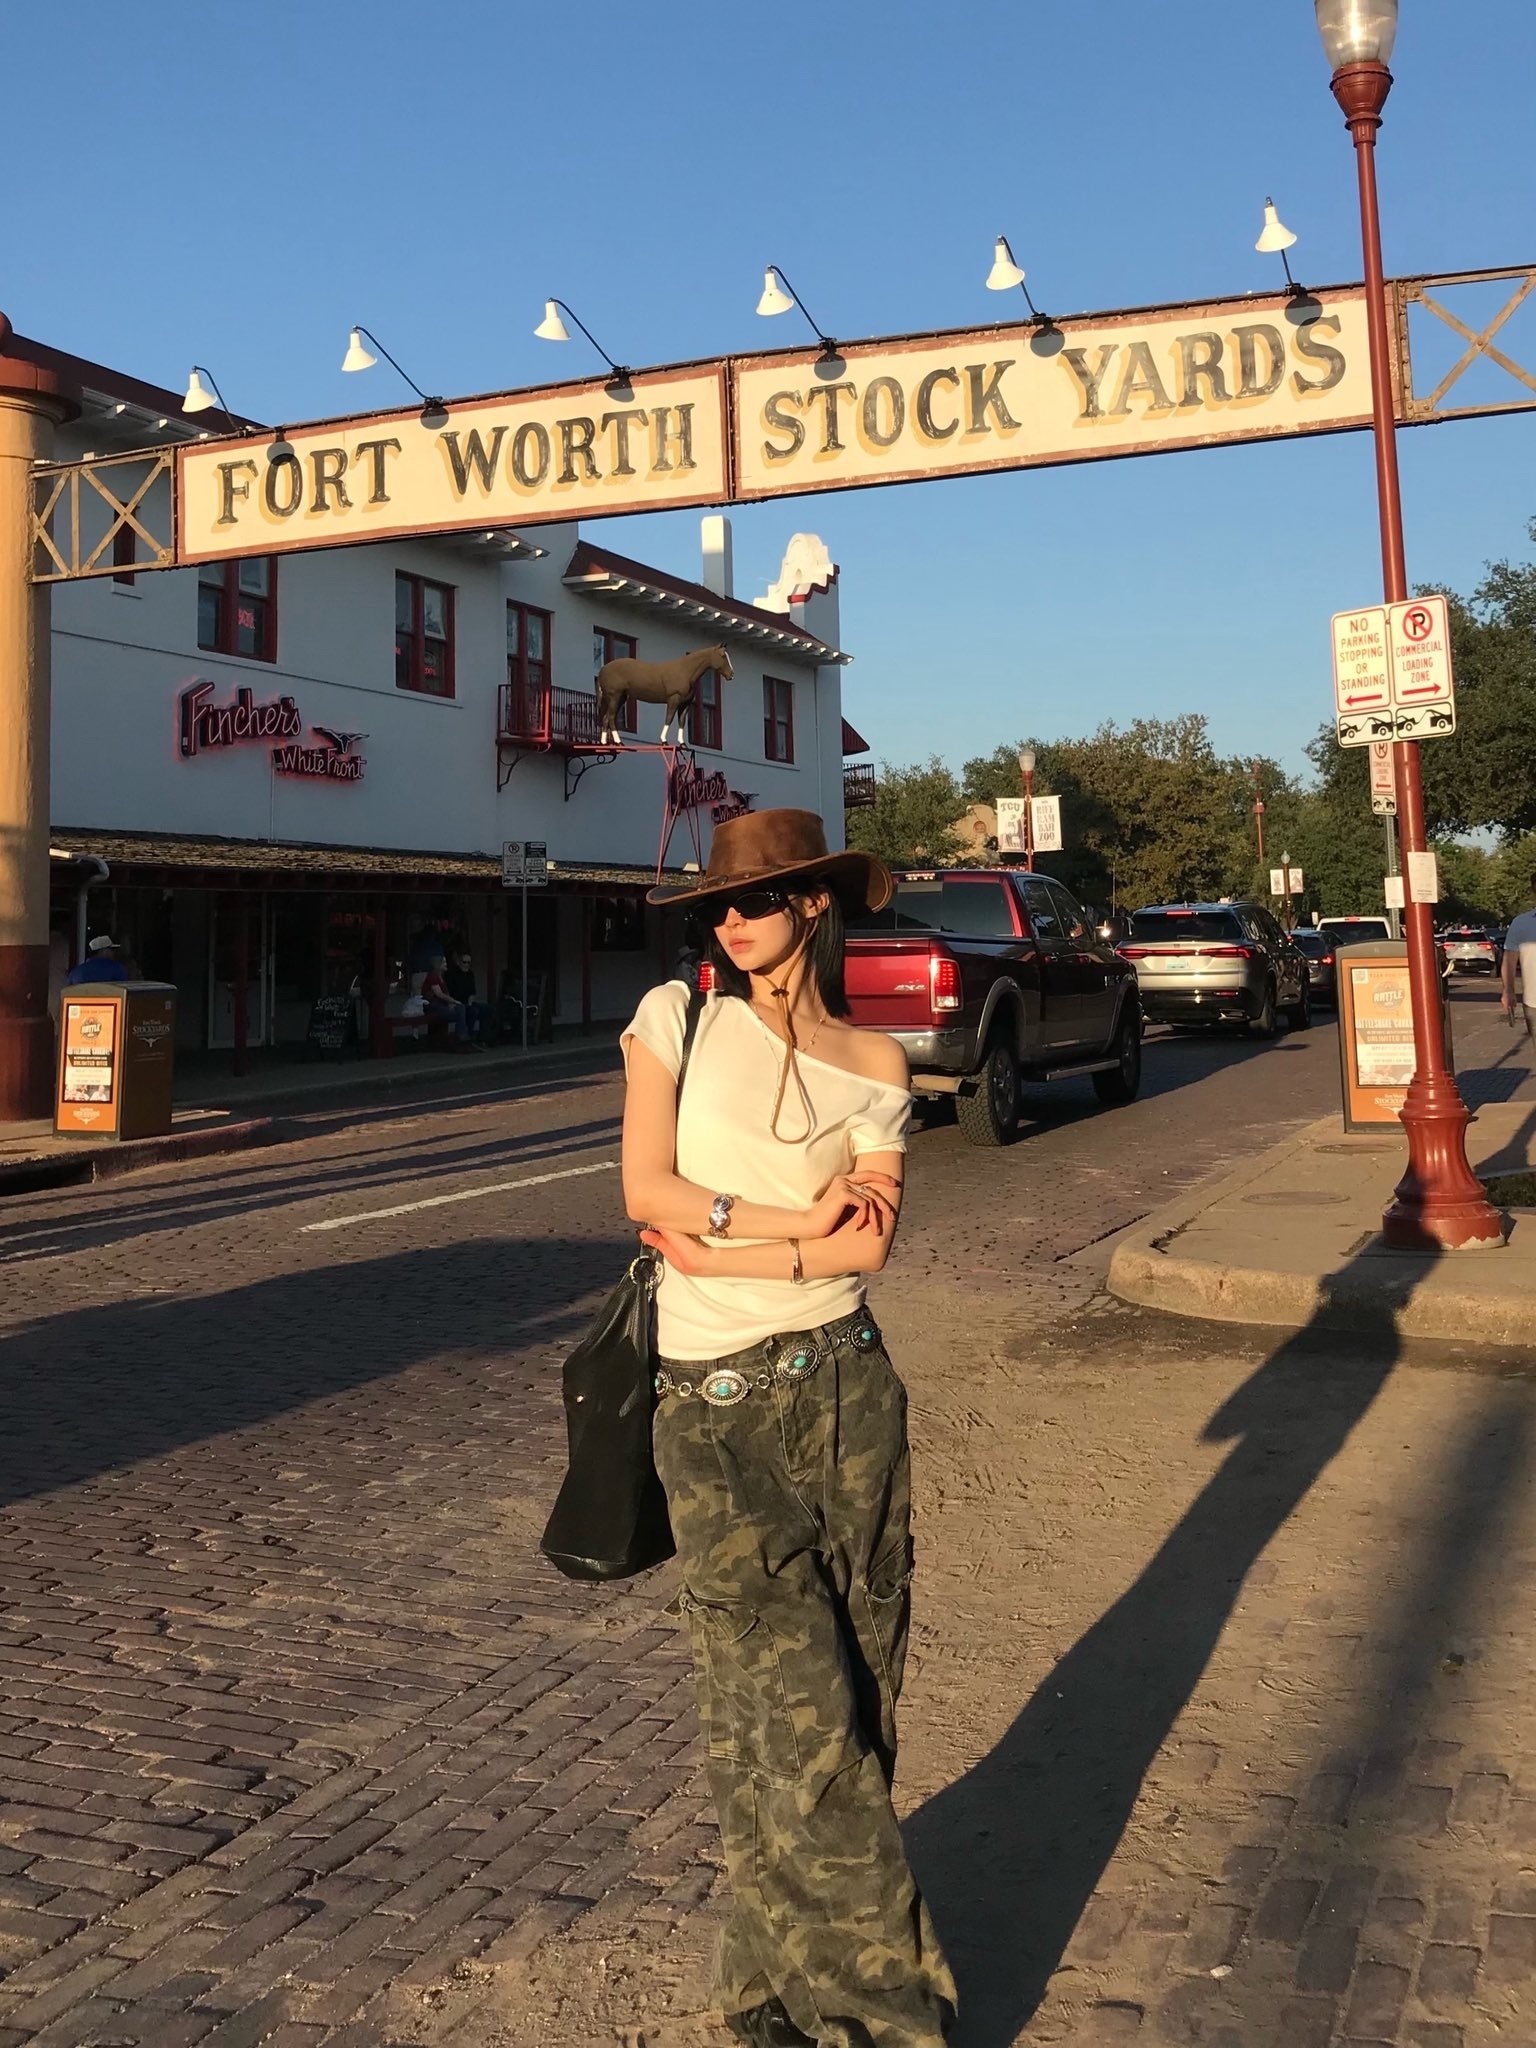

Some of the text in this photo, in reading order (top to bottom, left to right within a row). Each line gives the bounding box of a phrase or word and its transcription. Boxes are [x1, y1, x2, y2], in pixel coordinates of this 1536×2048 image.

[763, 313, 1347, 461] STOCK YARDS
[215, 401, 698, 526] FORT WORTH
[1350, 618, 1369, 634] NO
[1341, 632, 1380, 648] PARKING
[1339, 646, 1383, 663] STOPPING
[1395, 640, 1443, 658] COMMERCIAL
[1355, 662, 1368, 675] OR
[1402, 657, 1434, 671] LOADING
[1340, 674, 1386, 691] STANDING
[1410, 670, 1431, 684] ZONE
[184, 682, 302, 755] Fincher's
[1000, 802, 1021, 812] TCU
[1039, 831, 1055, 841] ZOO
